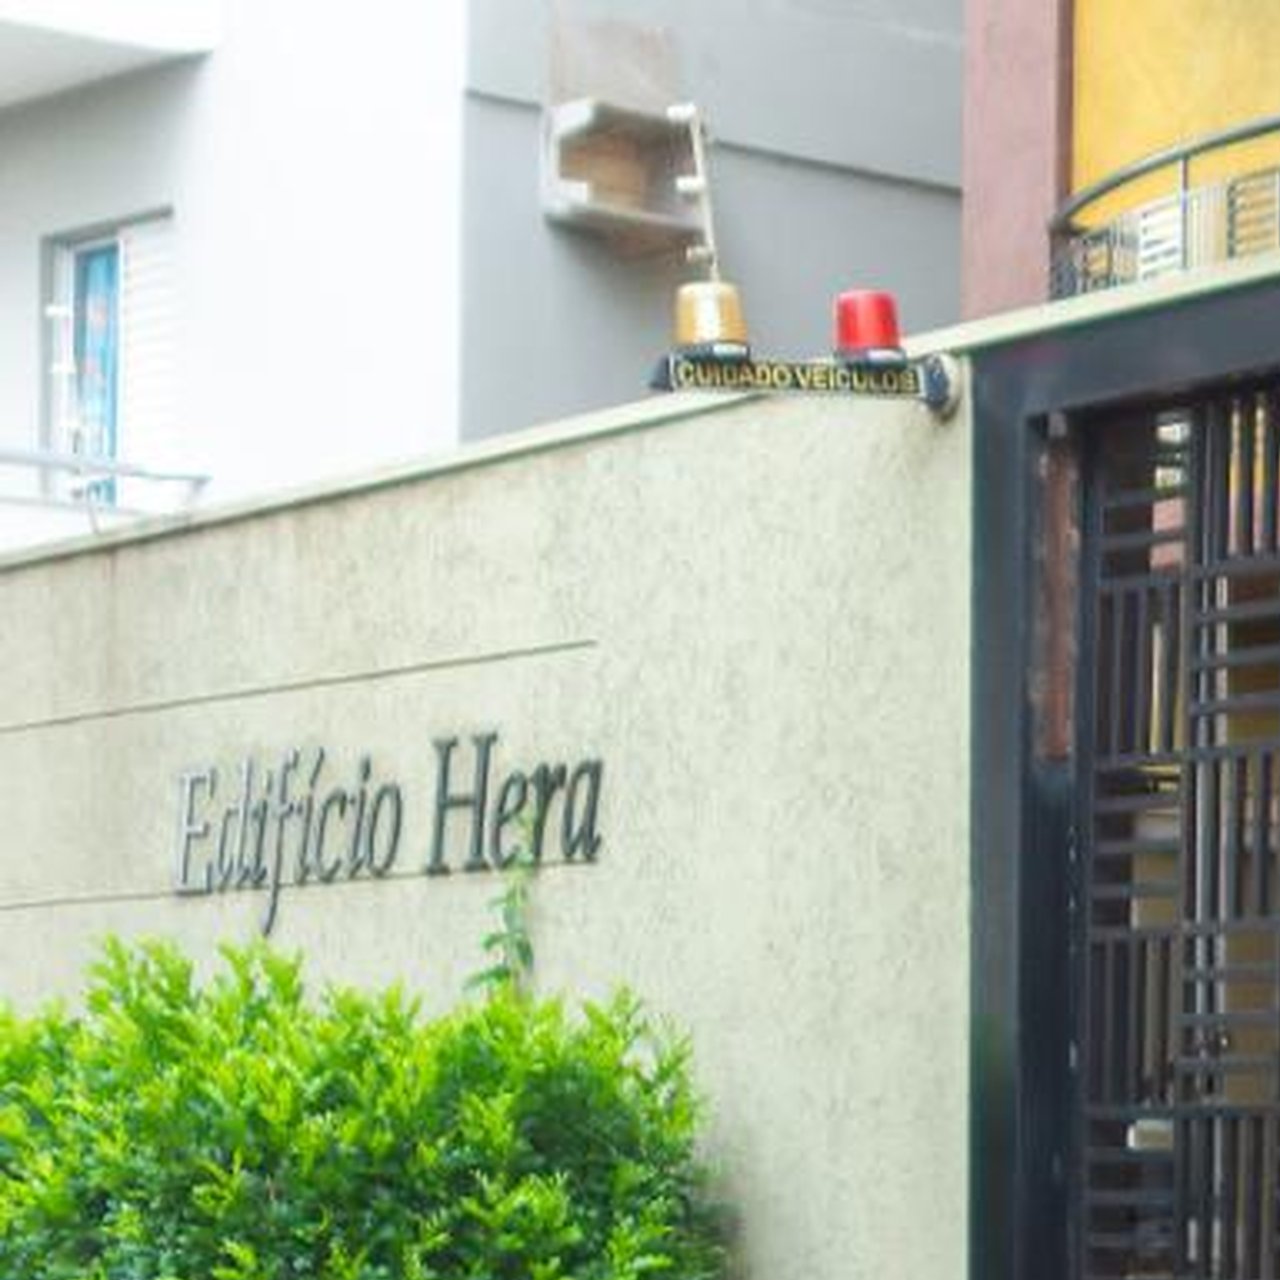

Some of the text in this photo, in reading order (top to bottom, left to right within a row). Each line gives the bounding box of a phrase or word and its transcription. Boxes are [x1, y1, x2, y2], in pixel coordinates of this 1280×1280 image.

[676, 361, 791, 388] CUIDADO
[174, 731, 604, 936] Edifício Hera
